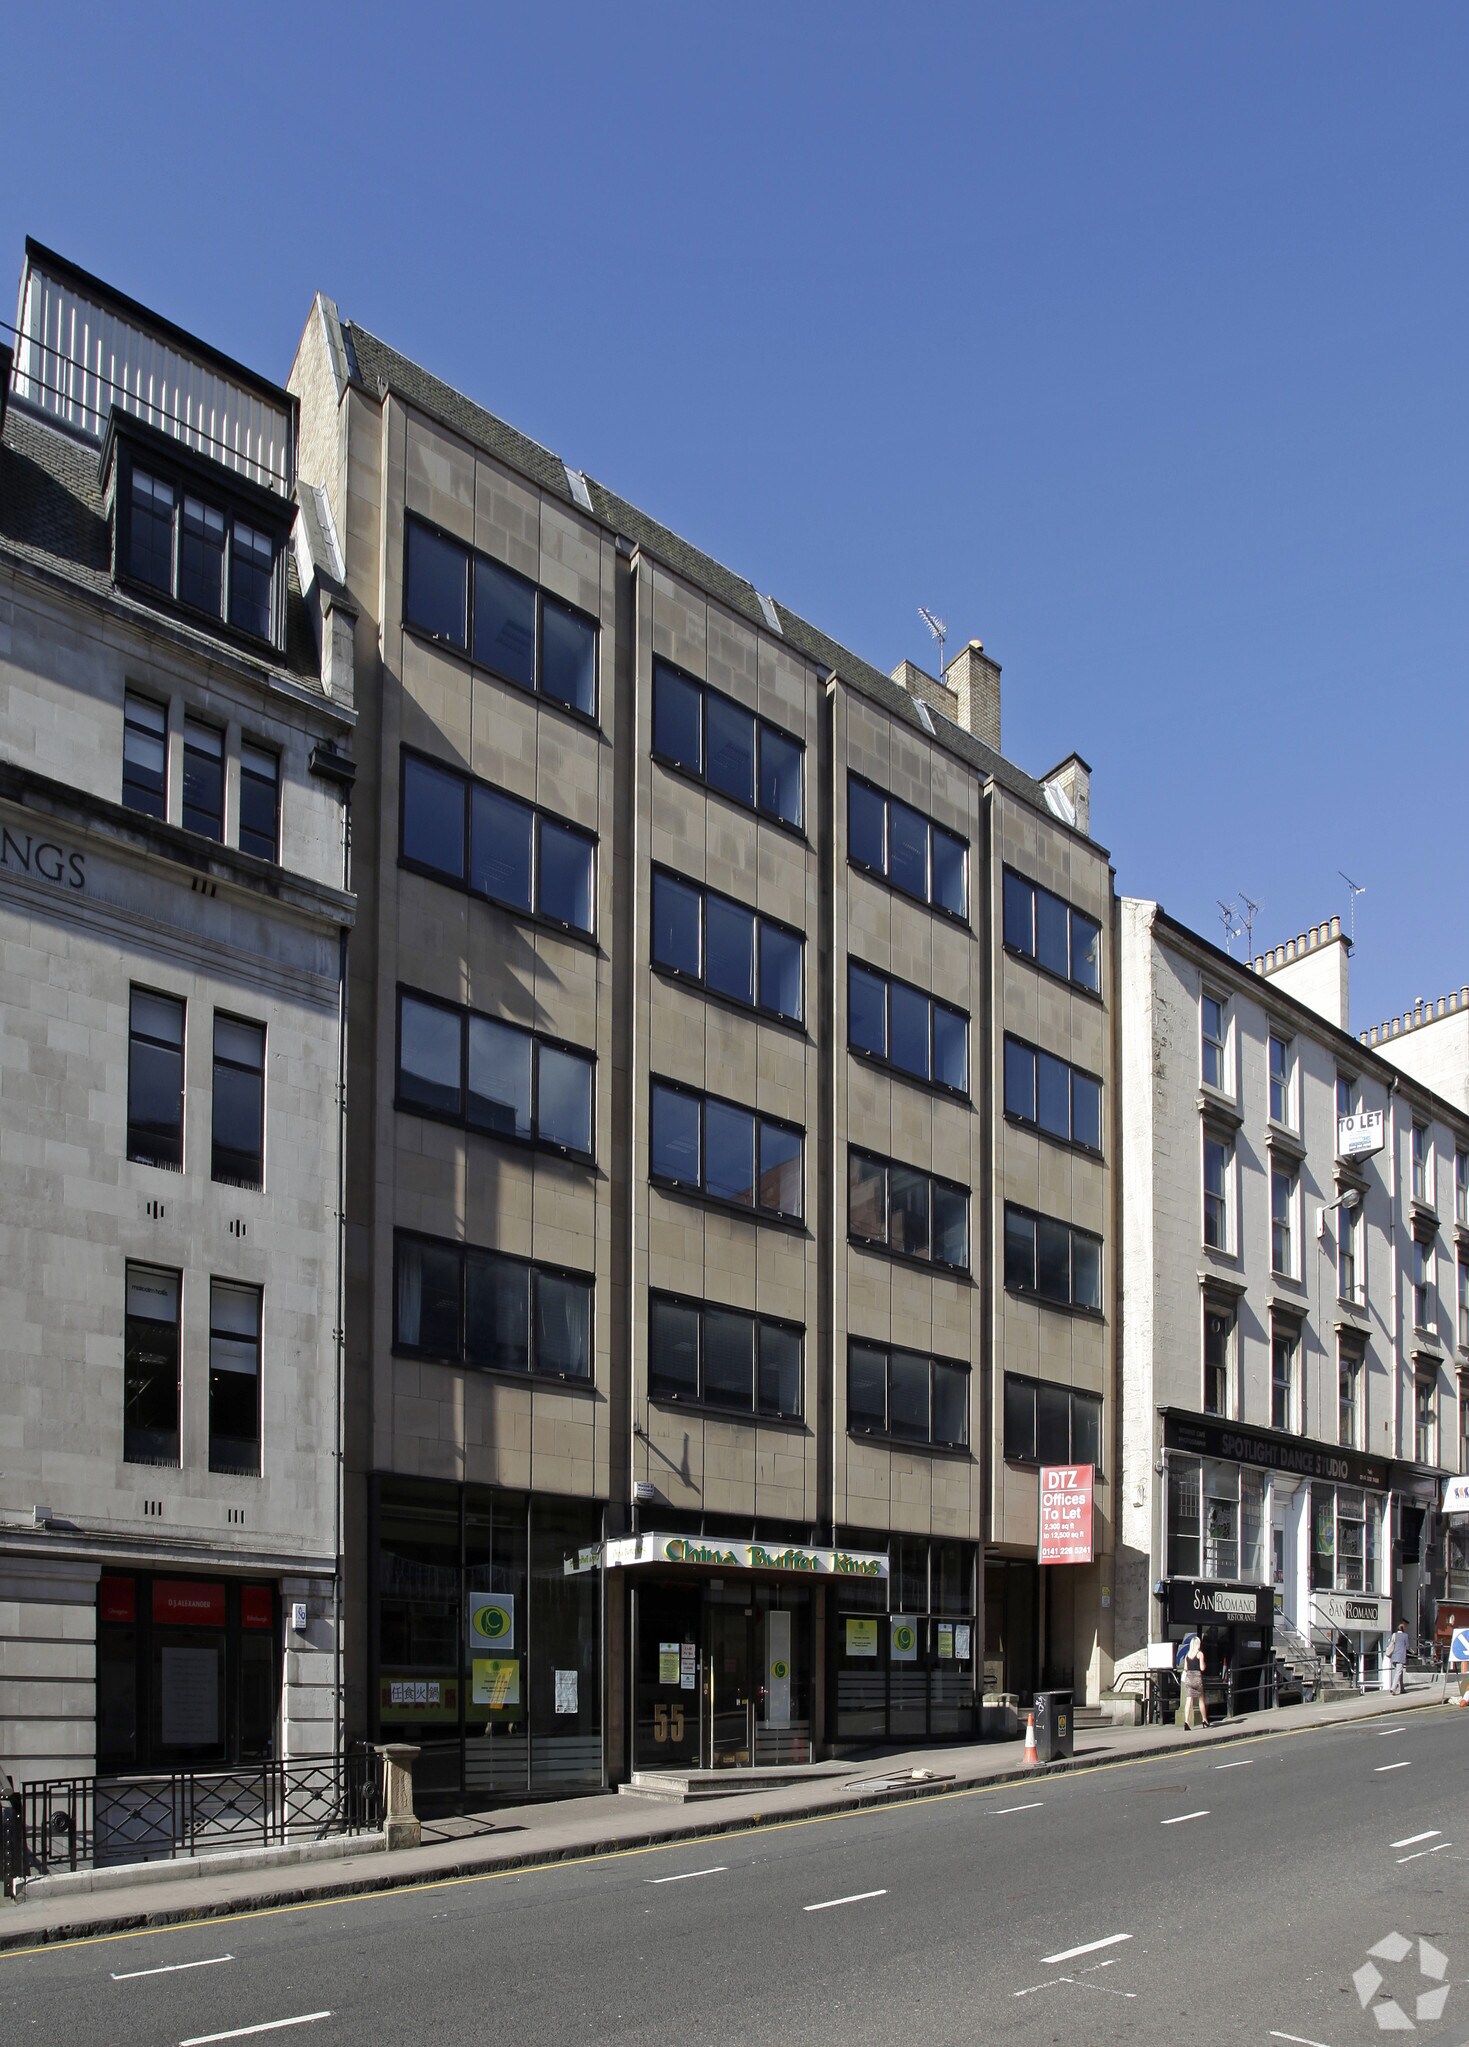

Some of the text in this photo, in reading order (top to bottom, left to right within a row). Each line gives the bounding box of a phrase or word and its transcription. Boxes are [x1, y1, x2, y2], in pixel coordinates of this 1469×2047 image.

[1339, 1112, 1381, 1132] TO LET
[1222, 1434, 1348, 1480] SPOTLIGHT DANCE STUDIO
[1048, 1470, 1077, 1489] DTZ
[1043, 1493, 1086, 1507] Offices
[1043, 1507, 1081, 1520] To Let
[1061, 1523, 1069, 1532] sq
[1071, 1530, 1079, 1539] sq
[664, 1539, 741, 1566] China
[746, 1546, 819, 1571] Buffet
[830, 1552, 881, 1576] King
[1042, 1547, 1058, 1555] 0141
[1226, 1613, 1257, 1622] RISTORANTE
[654, 1704, 685, 1742] 55
